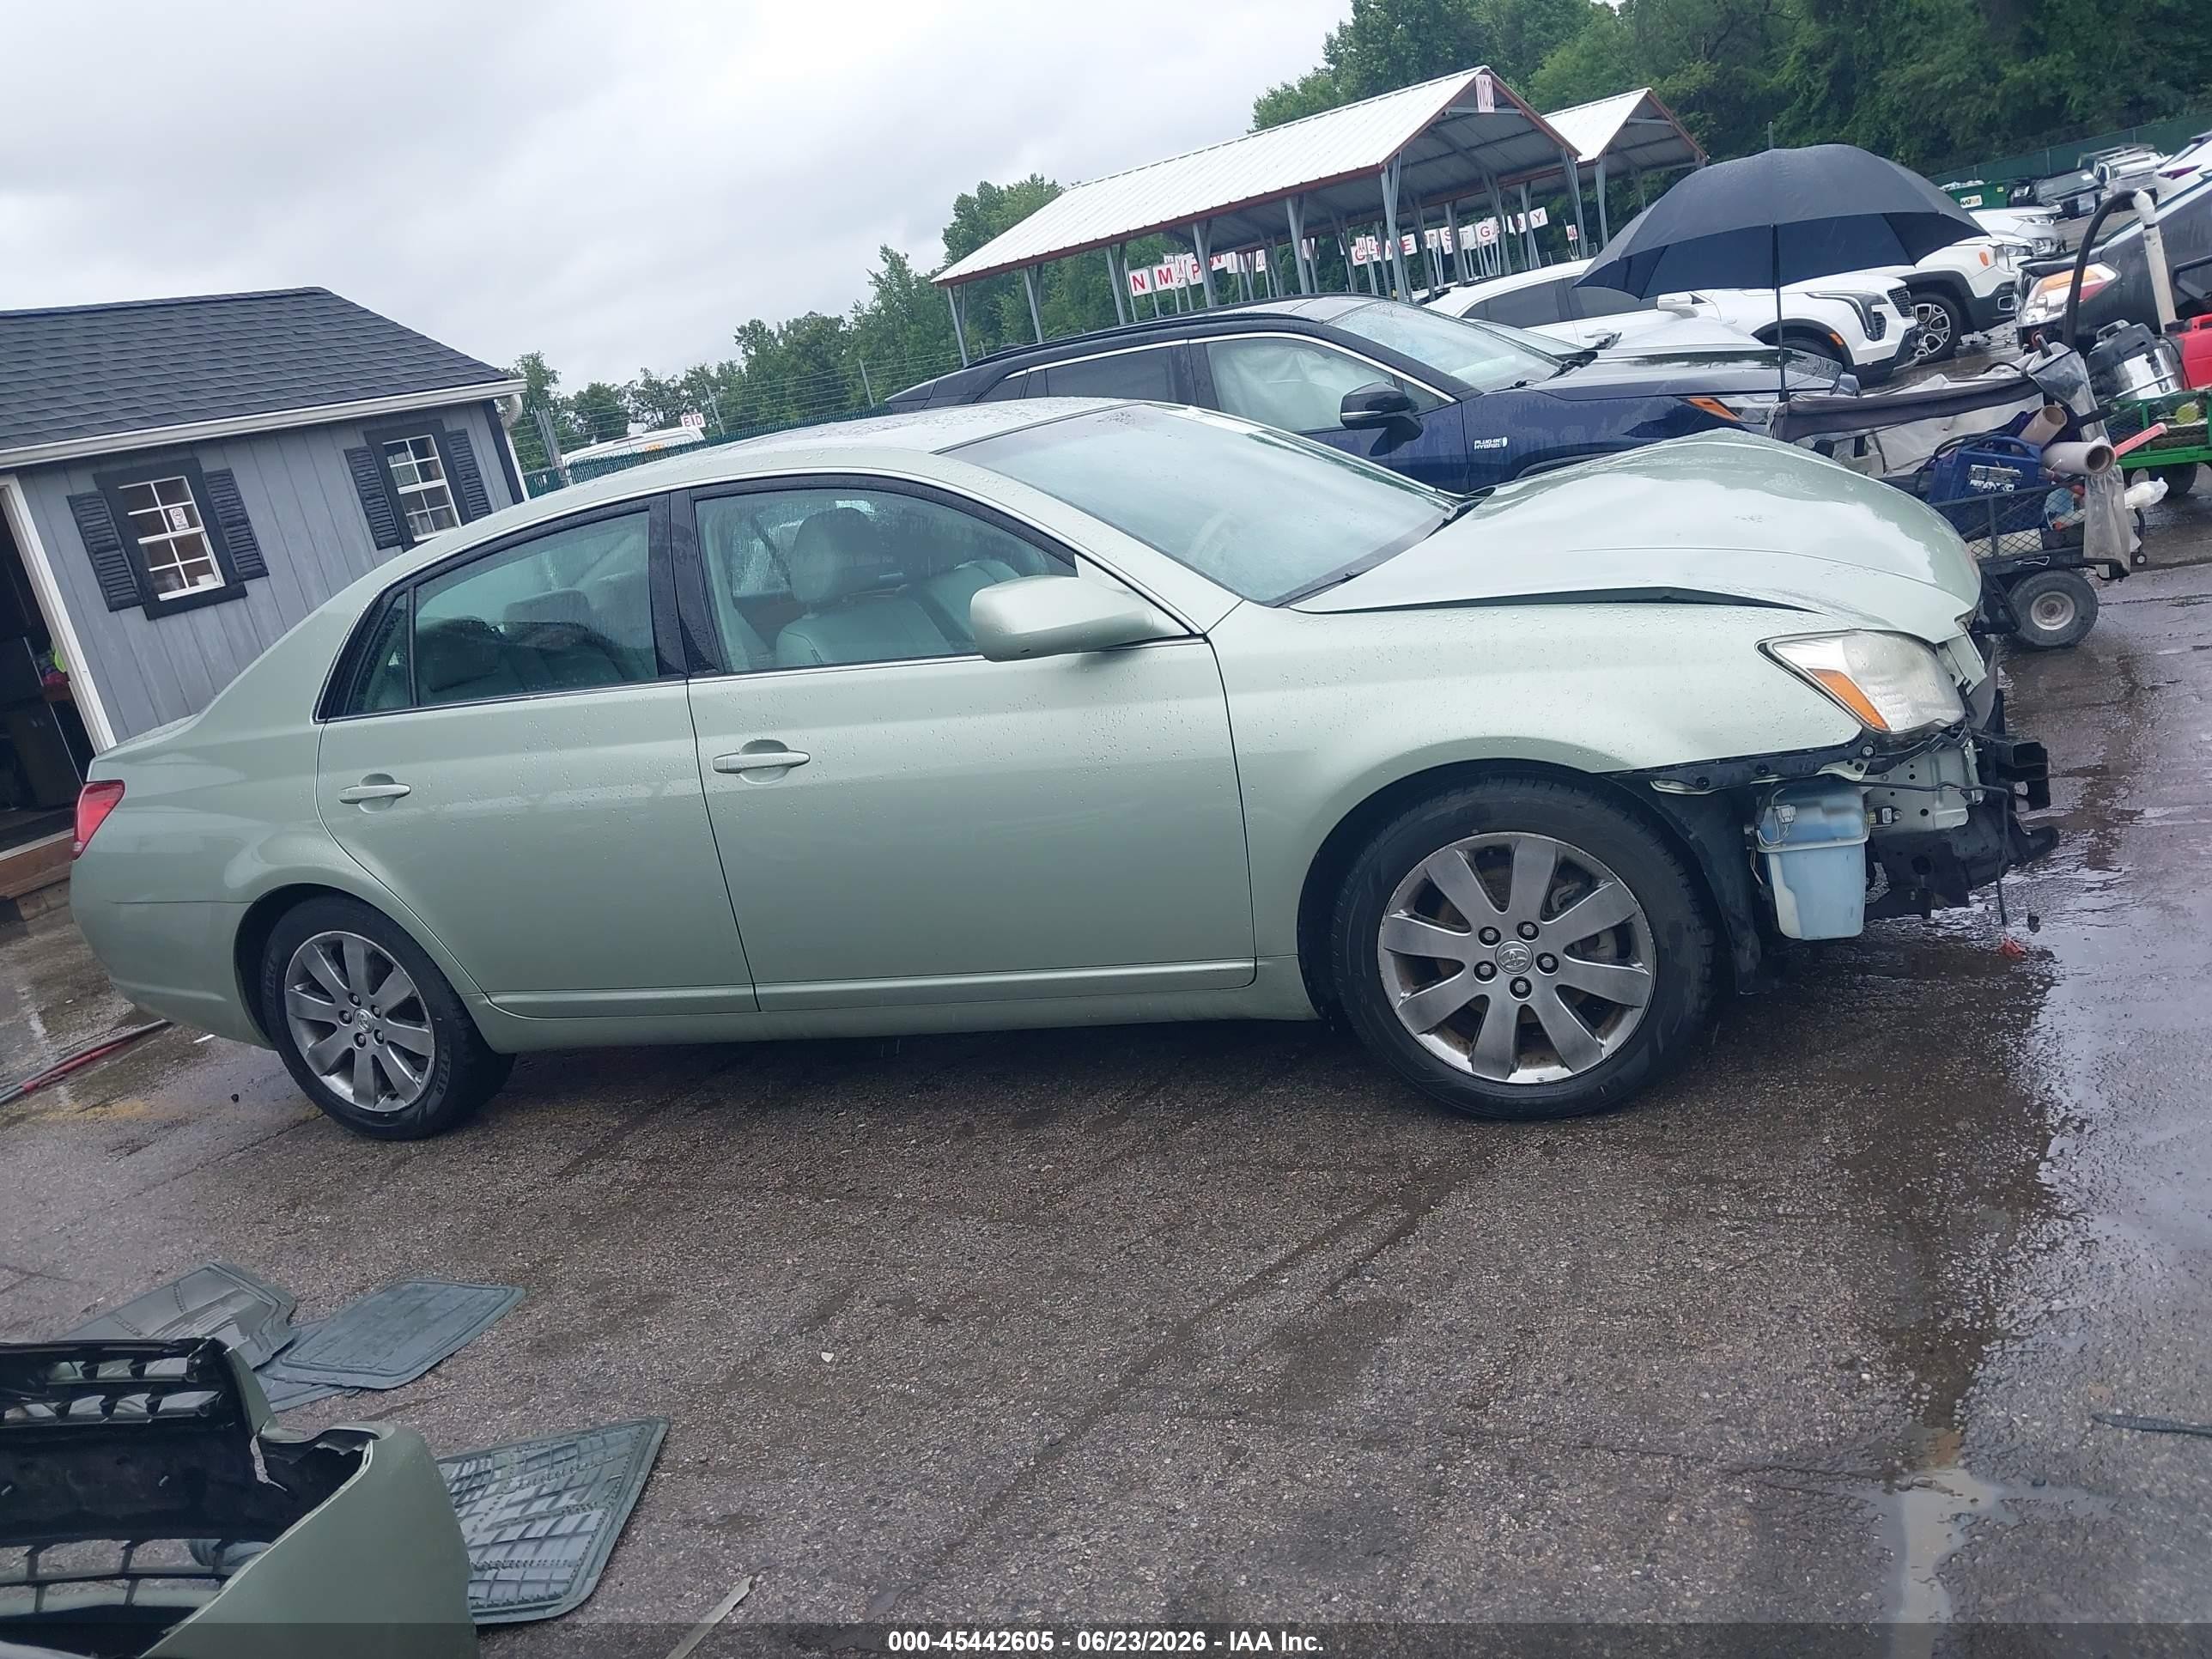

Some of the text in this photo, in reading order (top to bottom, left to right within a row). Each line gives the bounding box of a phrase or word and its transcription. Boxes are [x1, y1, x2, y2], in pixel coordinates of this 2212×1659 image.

[1533, 211, 1541, 223] Y
[1480, 226, 1491, 238] G
[1132, 273, 1146, 291] N
[1157, 267, 1174, 285] M
